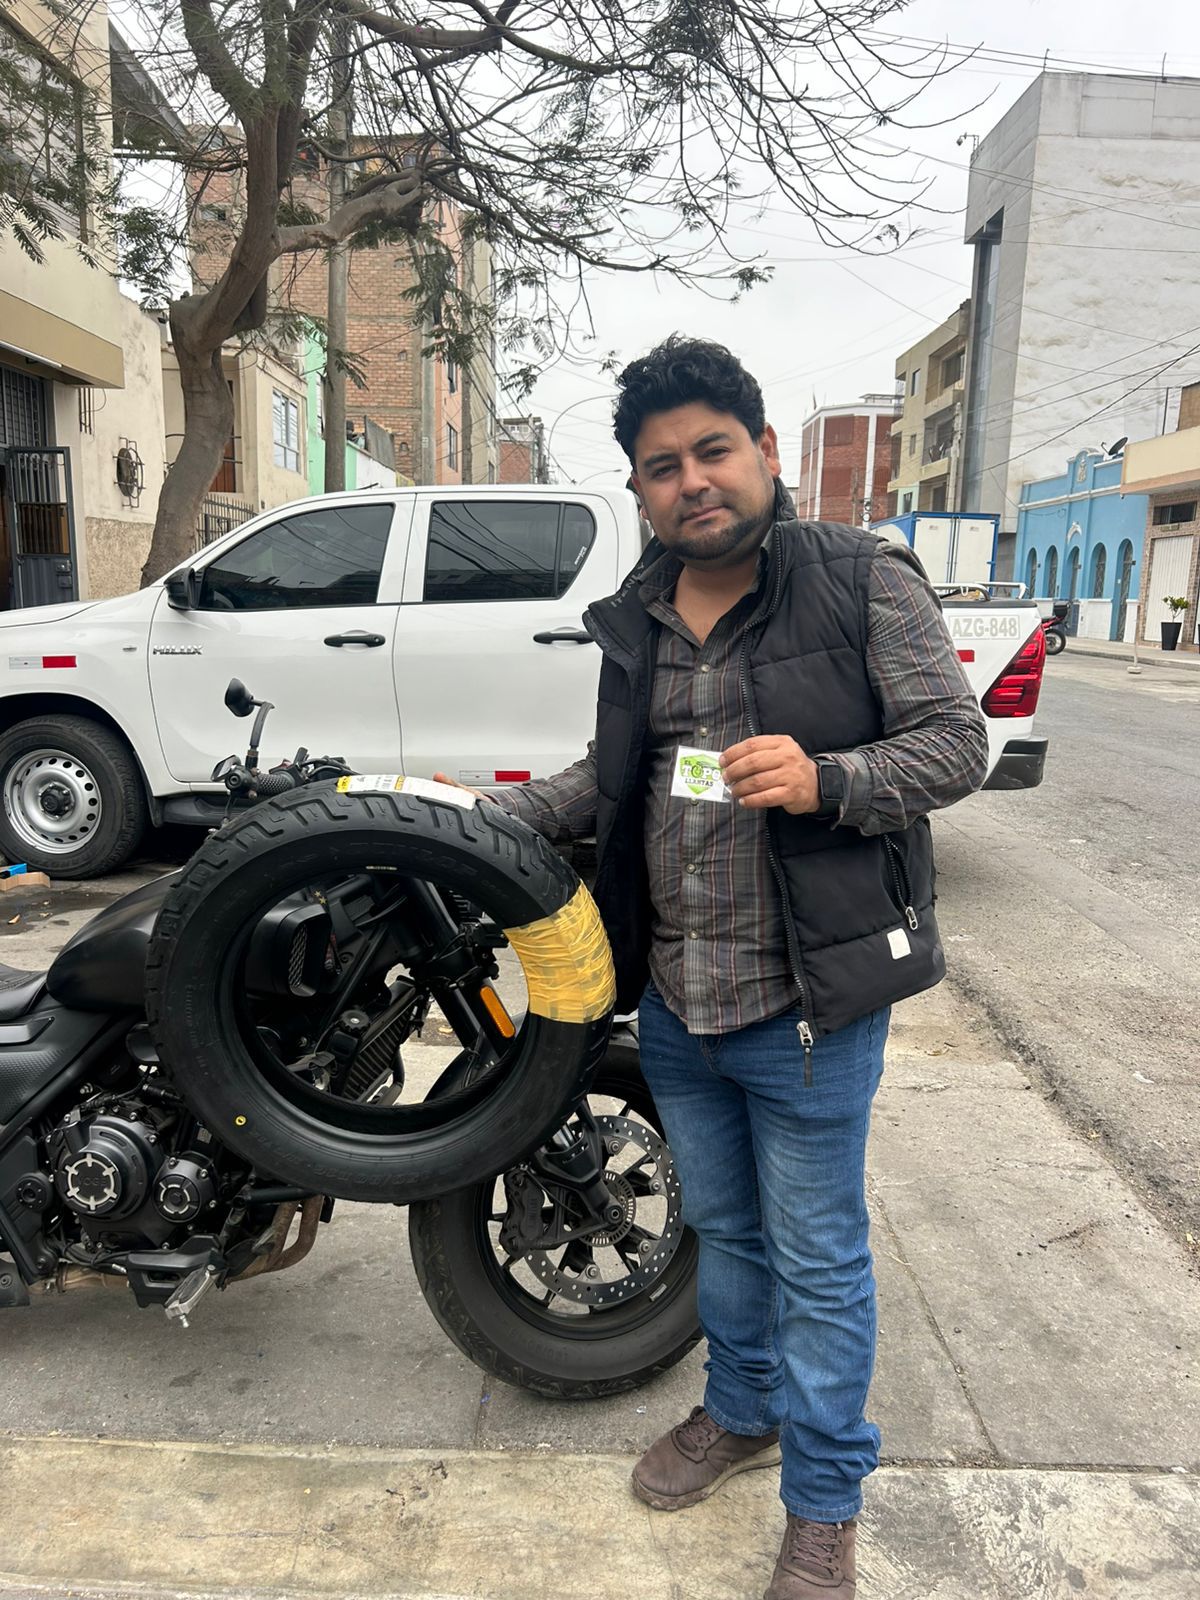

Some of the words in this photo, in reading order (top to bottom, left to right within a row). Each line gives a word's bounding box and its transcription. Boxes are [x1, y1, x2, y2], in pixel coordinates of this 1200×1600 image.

[952, 617, 1018, 638] AZG-848
[152, 644, 203, 656] HILUX
[684, 777, 714, 787] LLANTAS
